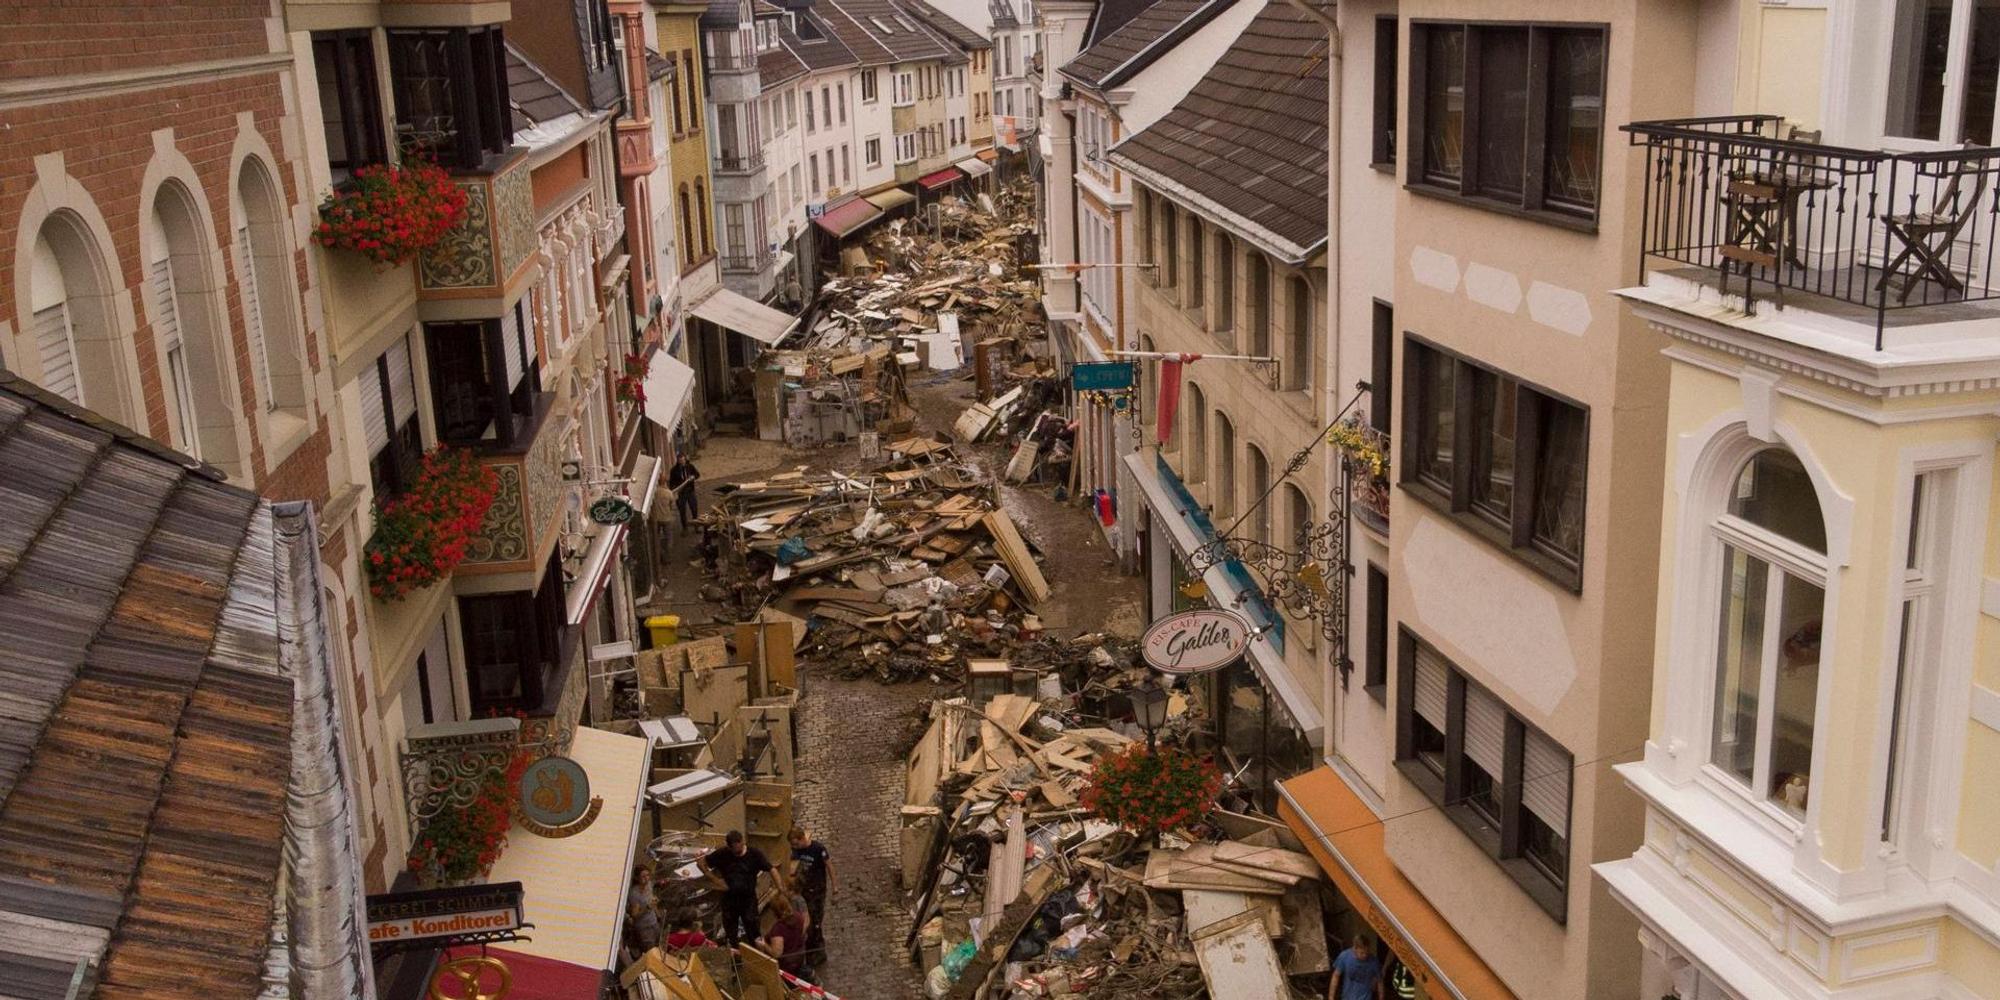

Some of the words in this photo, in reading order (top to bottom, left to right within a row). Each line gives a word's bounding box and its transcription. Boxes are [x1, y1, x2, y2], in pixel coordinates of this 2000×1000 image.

[1167, 621, 1230, 667] Galileo
[367, 900, 425, 918] CKEREI
[369, 923, 400, 939] afe
[413, 911, 511, 934] Konditorei
